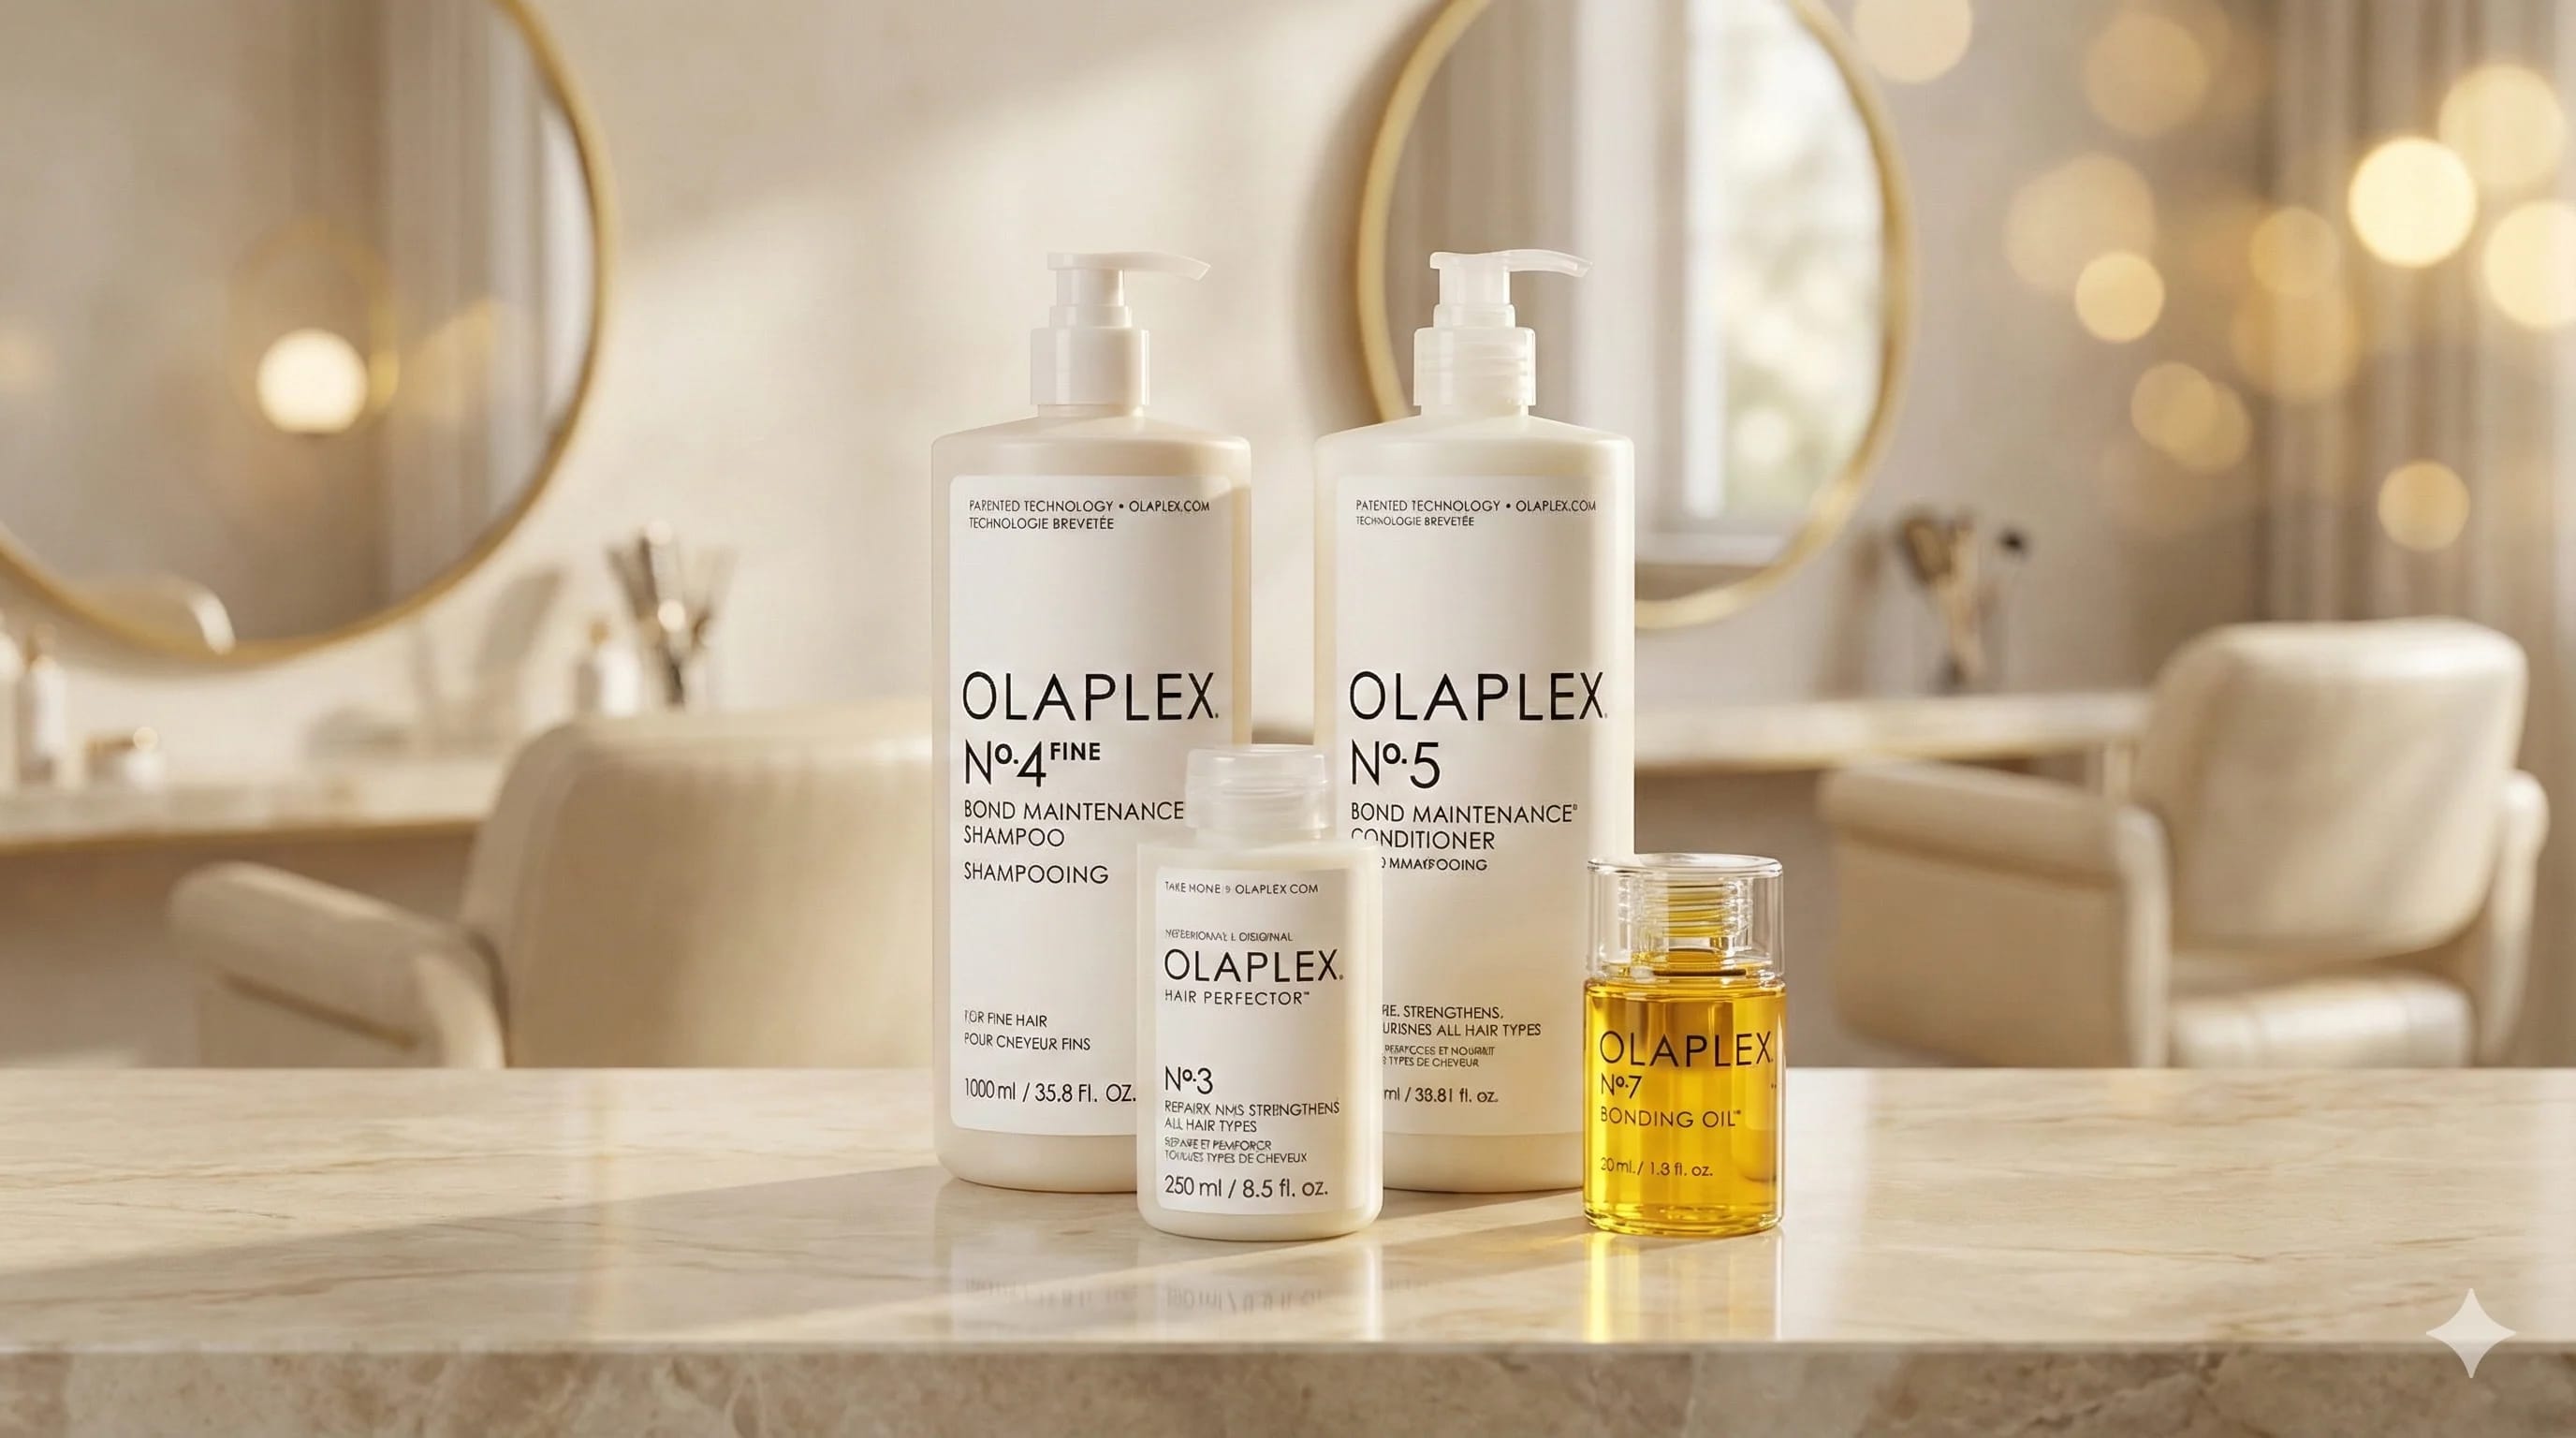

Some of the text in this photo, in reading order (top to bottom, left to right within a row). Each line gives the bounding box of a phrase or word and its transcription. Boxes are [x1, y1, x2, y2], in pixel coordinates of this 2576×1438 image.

[1024, 500, 1114, 513] TECHNOLOGY
[1129, 500, 1210, 513] OLAPLEX.COM
[1355, 499, 1596, 513] PATENTED TECHNOLOGY OLAPLEX.COM
[969, 515, 1115, 530] TECHNOLOGIE BREVETÉE
[1050, 742, 1101, 760] FINE
[964, 800, 1184, 821] BOND MAINTENANCE
[1351, 802, 1405, 822] BOND
[963, 825, 1065, 847] SHAMPOO
[963, 861, 1109, 884] SHAMPOOING
[1165, 881, 1186, 893] TAKE
[1165, 989, 1196, 1004] HAIR
[988, 1012, 1013, 1026] FINE
[1017, 1014, 1047, 1028] HAIR
[1383, 1022, 1542, 1036] URISNES ALL HAIR TYPES
[964, 1032, 993, 1047] POUR
[1061, 1037, 1091, 1051] FINS
[1439, 1047, 1449, 1056] ET
[1389, 1057, 1414, 1066] TYPES
[1417, 1058, 1430, 1067] DE
[965, 1078, 994, 1099] 1000
[998, 1081, 1016, 1100] ml
[1022, 1082, 1031, 1103] /
[1034, 1083, 1073, 1103] 35.8
[1383, 1087, 1400, 1101] ml
[1404, 1087, 1412, 1102] /
[1459, 1087, 1472, 1103] fl.
[1601, 1106, 1694, 1128] BONDING
[1186, 1119, 1215, 1132] HAIR
[1220, 1120, 1257, 1133] TYPES
[1238, 1152, 1254, 1164] DE
[1256, 1152, 1308, 1164] CHEVEUX
[1651, 1162, 1671, 1176] 1.3
[1674, 1162, 1688, 1177] fl.
[1691, 1165, 1714, 1177] oz.
[1164, 1175, 1328, 1199] 250 ml / 8.5 fl. oz.
